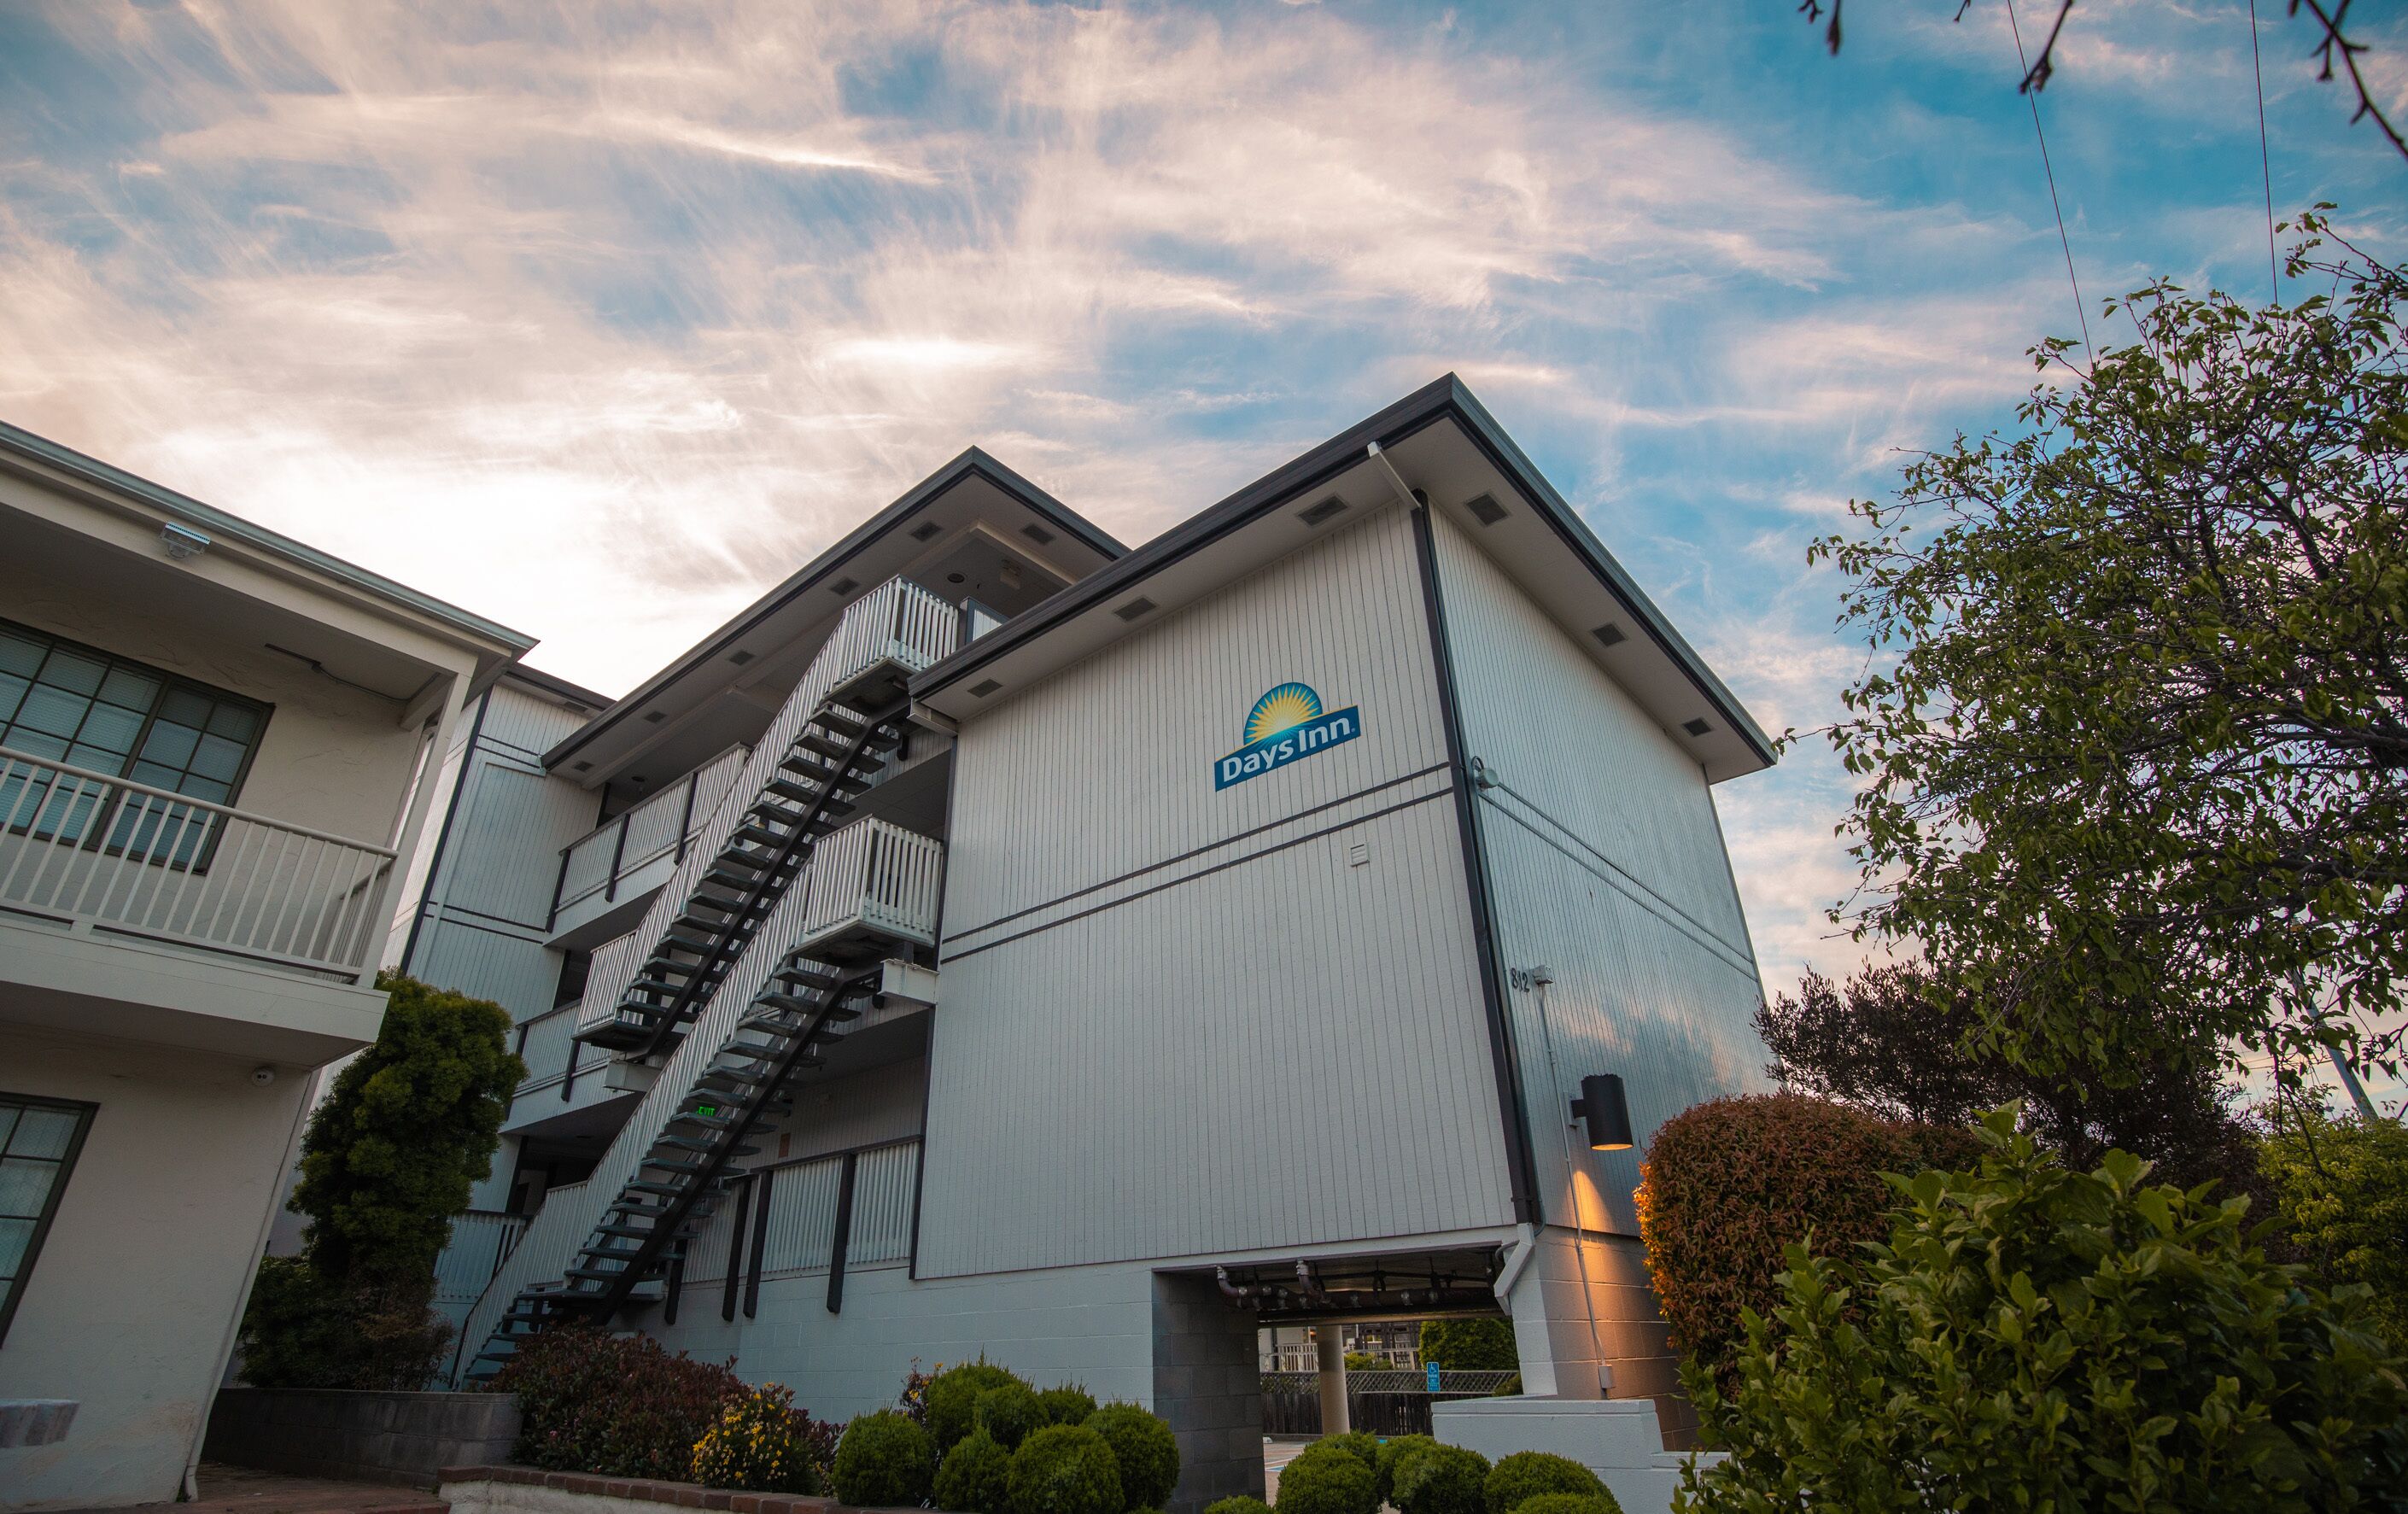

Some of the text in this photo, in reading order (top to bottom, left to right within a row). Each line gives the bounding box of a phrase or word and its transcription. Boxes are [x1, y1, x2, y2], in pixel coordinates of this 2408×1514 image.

[1222, 716, 1351, 782] Days Inn
[1511, 967, 1530, 993] 812
